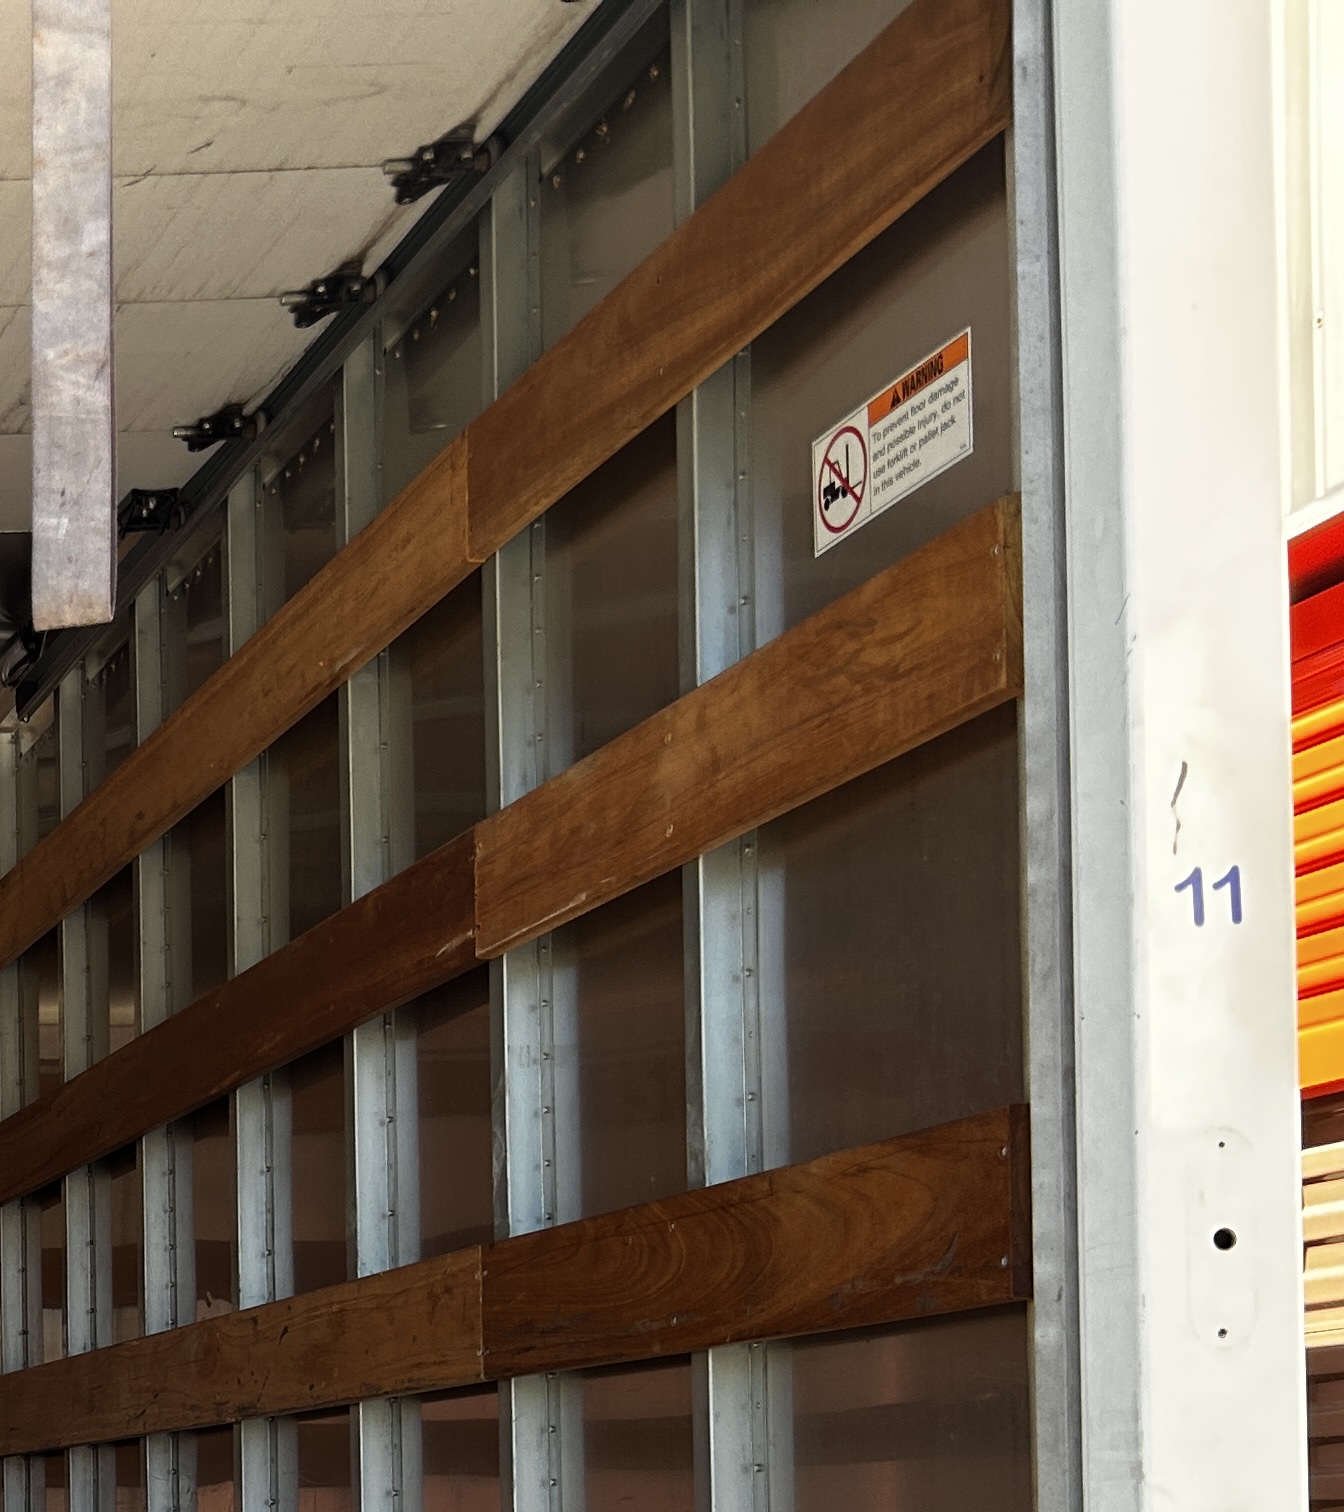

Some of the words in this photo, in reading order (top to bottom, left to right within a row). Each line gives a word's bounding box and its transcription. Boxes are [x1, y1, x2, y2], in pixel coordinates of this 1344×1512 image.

[902, 355, 943, 399] WARNING
[872, 432, 881, 443] To
[882, 409, 909, 439] prevent
[928, 377, 959, 404] damage
[872, 448, 885, 462] and
[887, 426, 916, 449] possible
[942, 402, 951, 413] do
[953, 391, 966, 405] not
[873, 465, 885, 479] use
[887, 449, 908, 471] forklift
[910, 443, 917, 454] or
[919, 427, 938, 449] pallet
[940, 415, 956, 436] jack
[881, 476, 893, 491] this
[895, 458, 921, 479] vehicle.
[1175, 864, 1242, 927] 11
